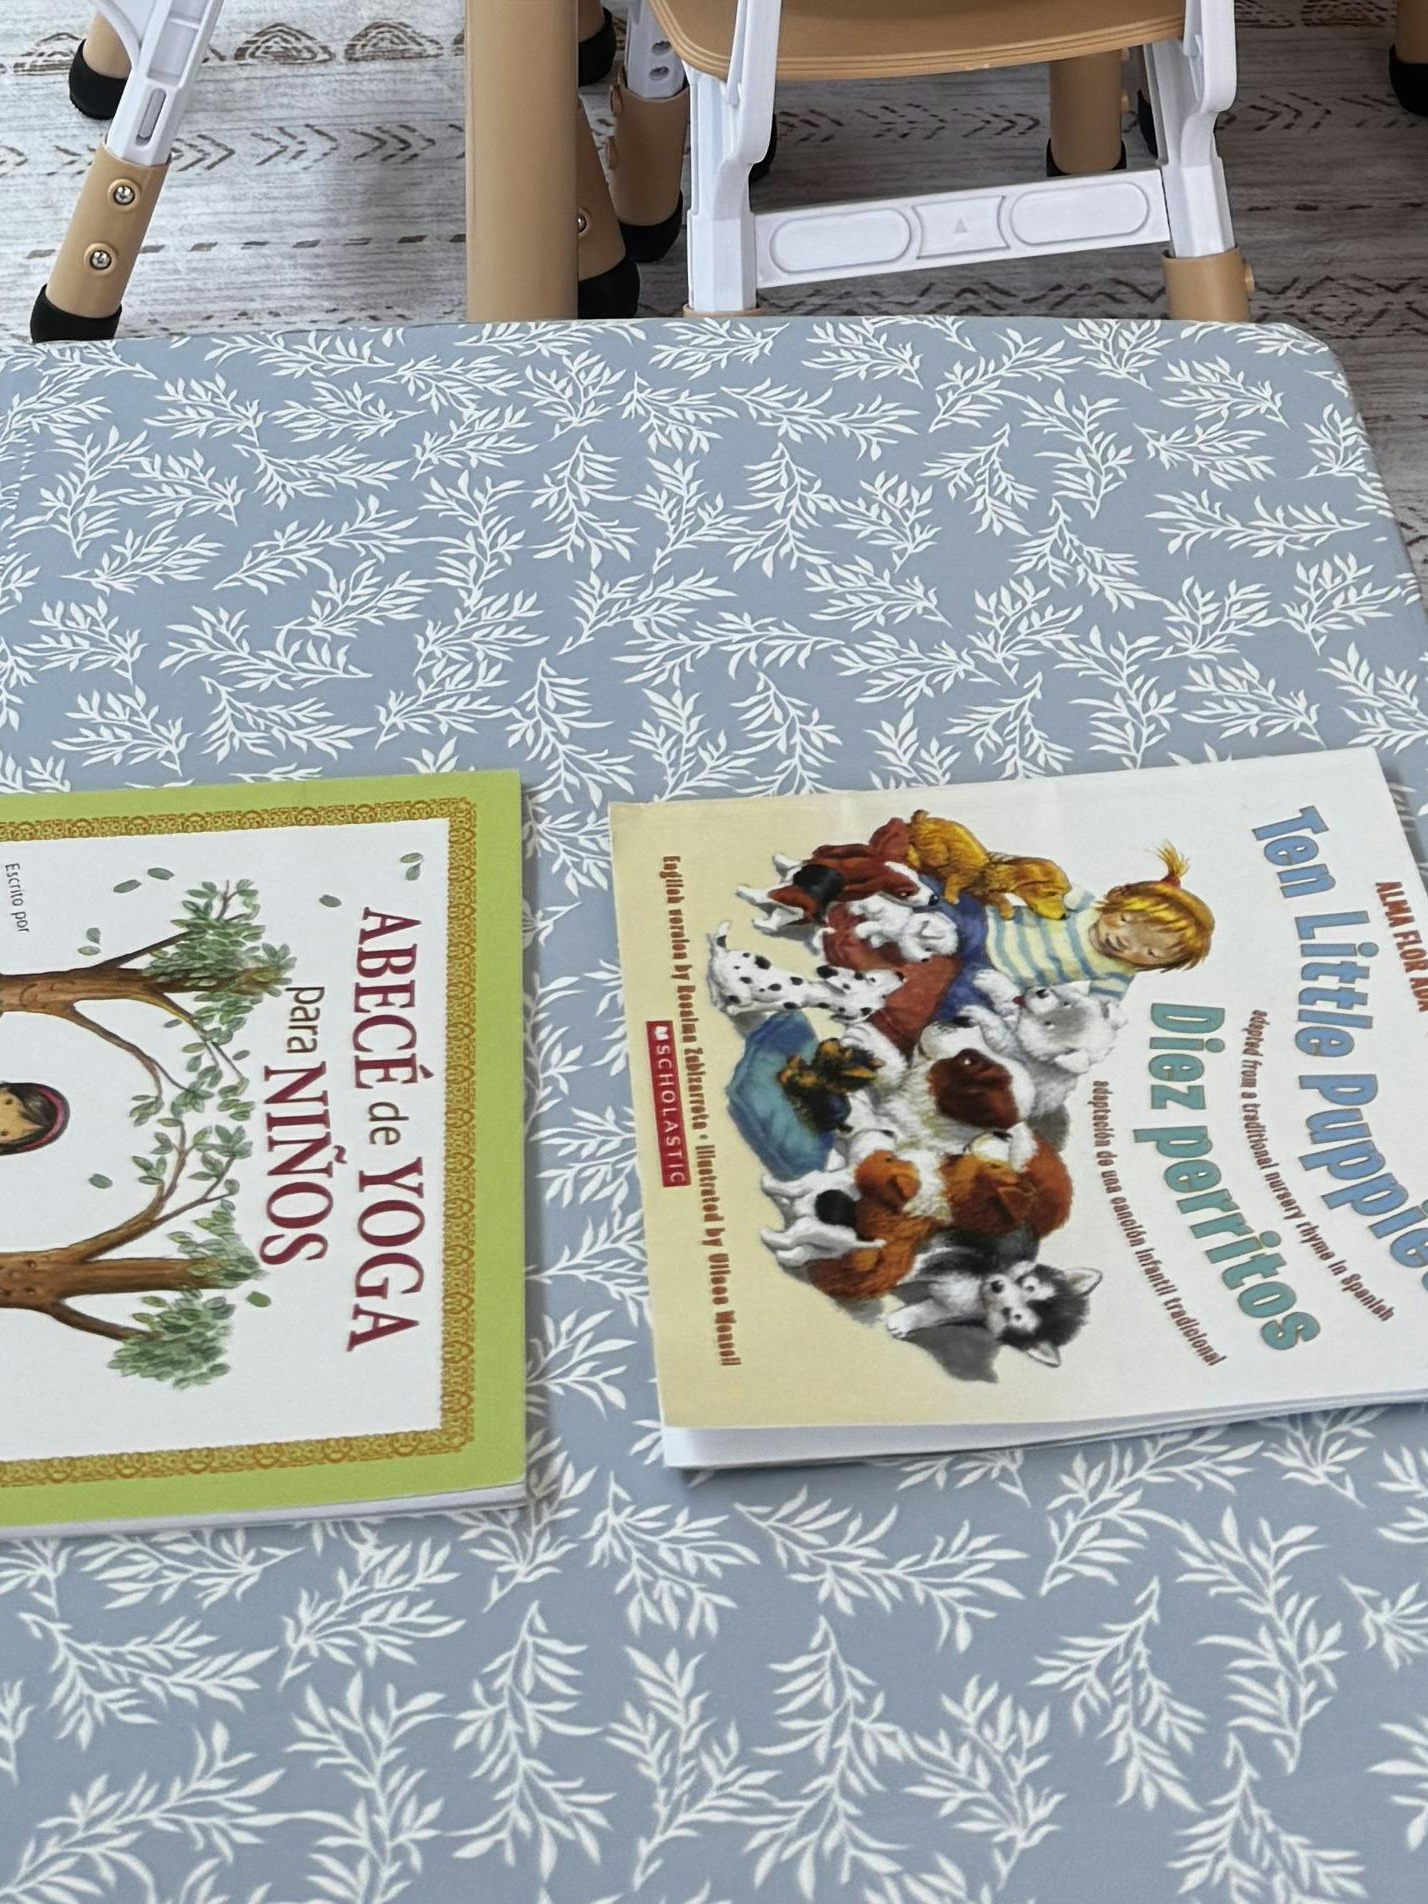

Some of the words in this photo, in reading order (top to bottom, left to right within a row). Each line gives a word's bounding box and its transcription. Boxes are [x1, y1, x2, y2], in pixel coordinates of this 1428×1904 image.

[5, 863, 28, 907] Escrito
[1251, 806, 1338, 900] Ten
[11, 911, 32, 934] por
[1375, 881, 1408, 928] ALMA
[1392, 931, 1425, 973] FLOR
[352, 907, 432, 1090] ABECÉ
[1294, 910, 1380, 1058] Little
[284, 986, 325, 1053] para
[1241, 1010, 1270, 1056] adapted
[1148, 1002, 1226, 1111] Diez
[1241, 1059, 1266, 1088] from
[368, 1101, 409, 1146] de
[653, 1044, 686, 1187] SCHOLASTIC
[669, 964, 697, 980] by
[699, 1226, 728, 1248] by
[1092, 1080, 1121, 1147] adaptación
[1240, 1092, 1256, 1100] a
[259, 1063, 346, 1267] NIÑOS
[1097, 1151, 1120, 1167] de
[1242, 1103, 1280, 1169] traditional
[1101, 1170, 1122, 1194] una
[1265, 1171, 1306, 1221] nursery
[345, 1158, 426, 1352] YOGA
[1133, 1126, 1321, 1352] perritos
[1136, 1247, 1174, 1295] infantil
[1294, 1222, 1334, 1262] rhyme
[1328, 1262, 1347, 1275] in
[1338, 1273, 1396, 1322] Spanish
[1163, 1297, 1226, 1367] tradicional
